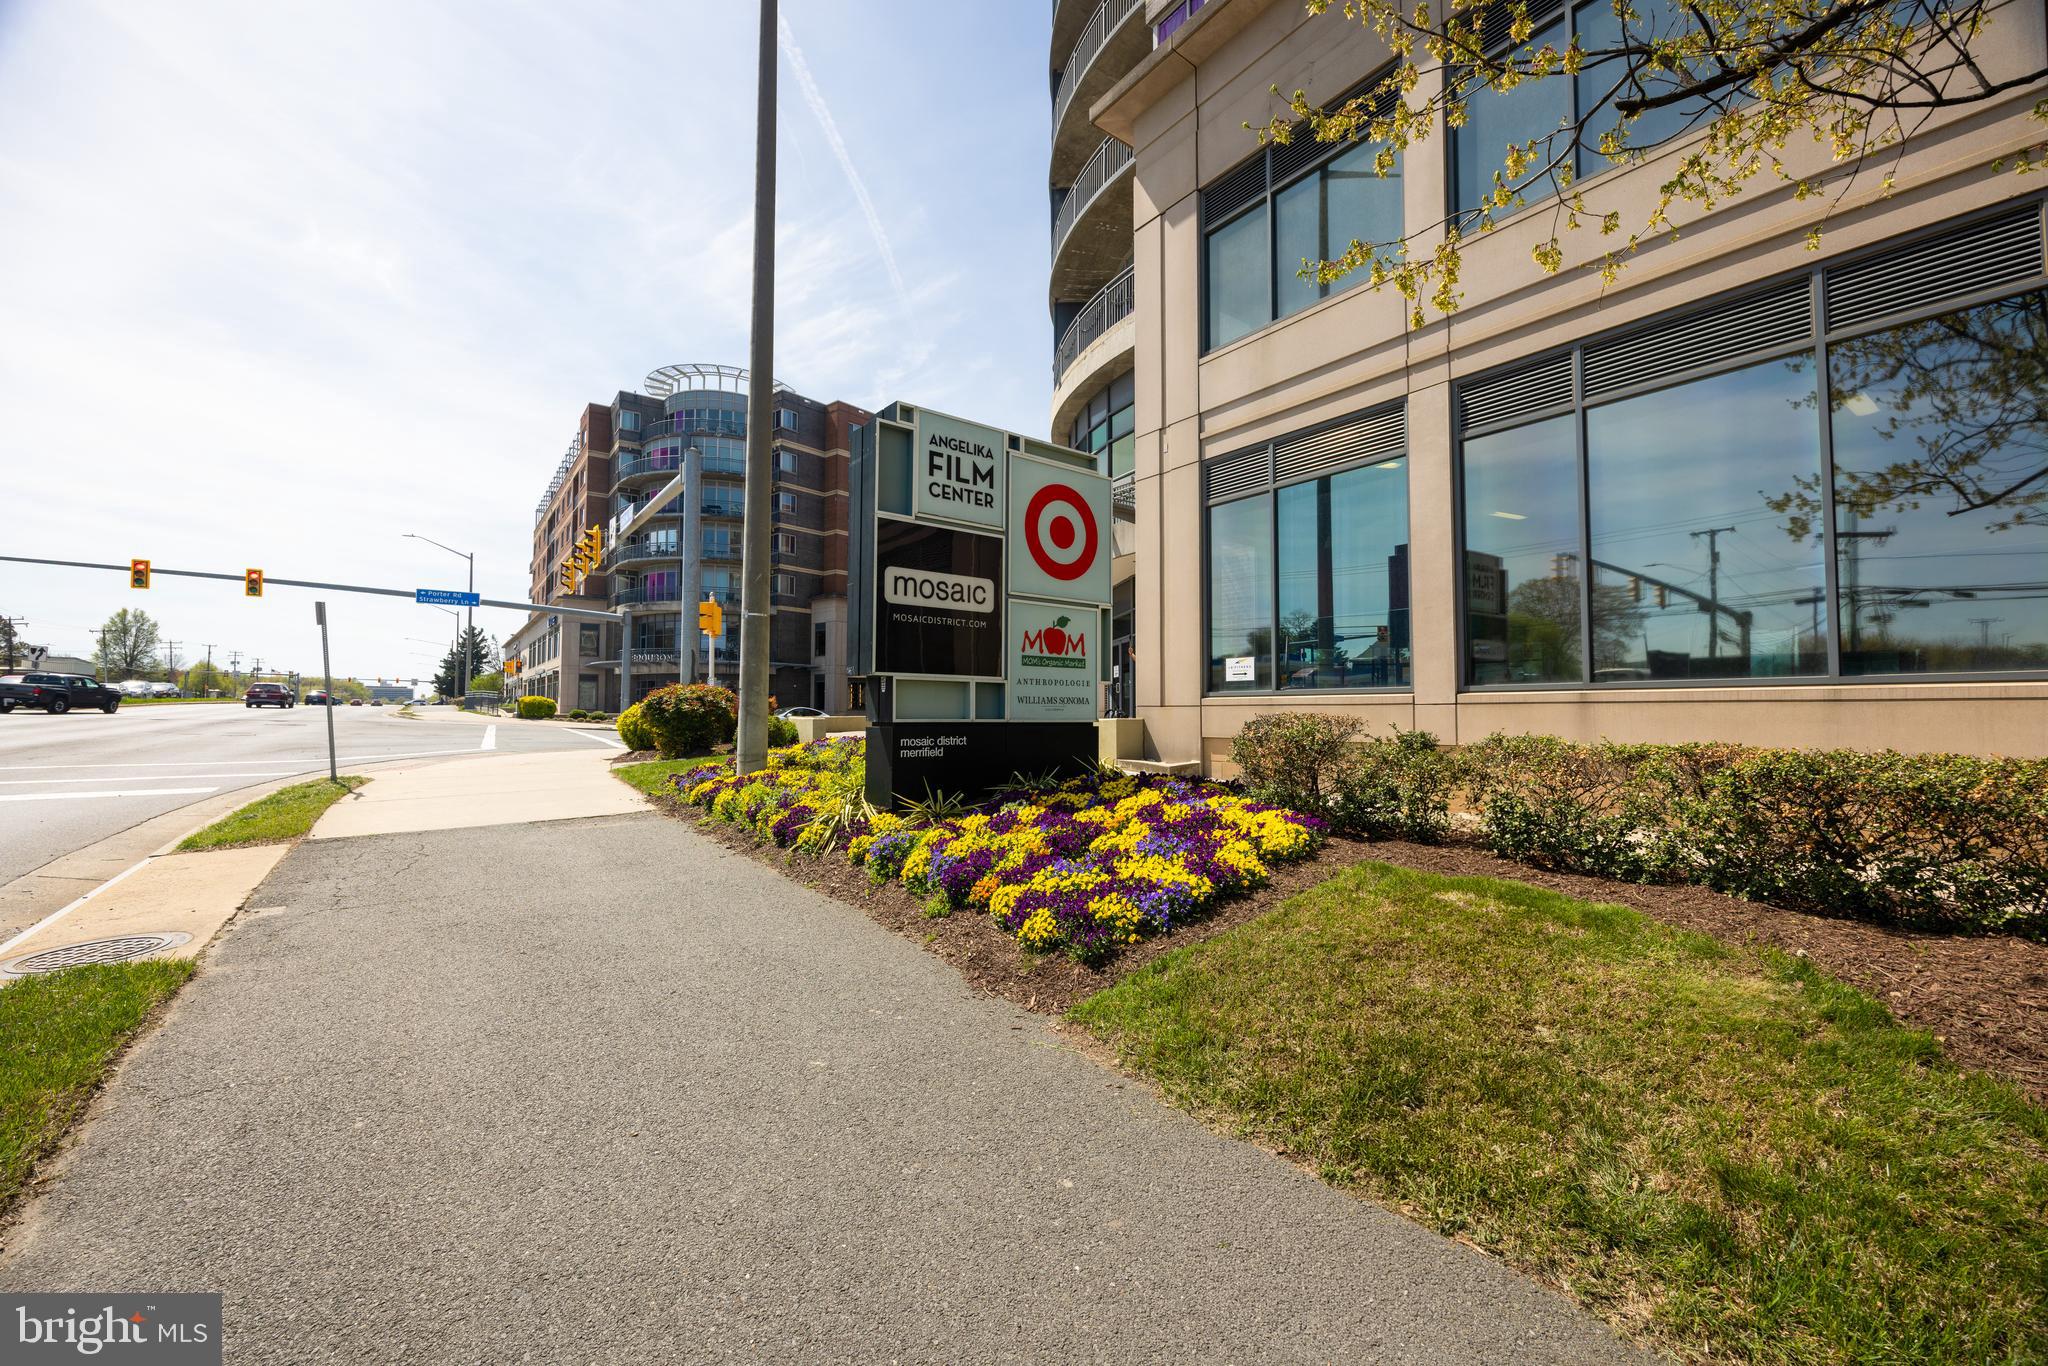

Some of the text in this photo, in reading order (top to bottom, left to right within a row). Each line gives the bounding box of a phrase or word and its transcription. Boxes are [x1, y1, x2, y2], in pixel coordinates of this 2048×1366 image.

[929, 434, 994, 460] ANGELIKA
[929, 450, 994, 489] FILM
[929, 482, 994, 508] CENTER
[893, 575, 986, 605] mosaic
[419, 596, 459, 605] Strawberry
[893, 613, 987, 628] MOSAICDISTRICT.COM
[1021, 629, 1086, 657] MOM
[1042, 658, 1064, 667] Organic
[1016, 678, 1090, 687] ANTHROPOLOGIE
[1017, 696, 1090, 704] WILLIAMS SONOMA
[900, 736, 967, 747] mosaic district
[900, 747, 944, 758] merrifield
